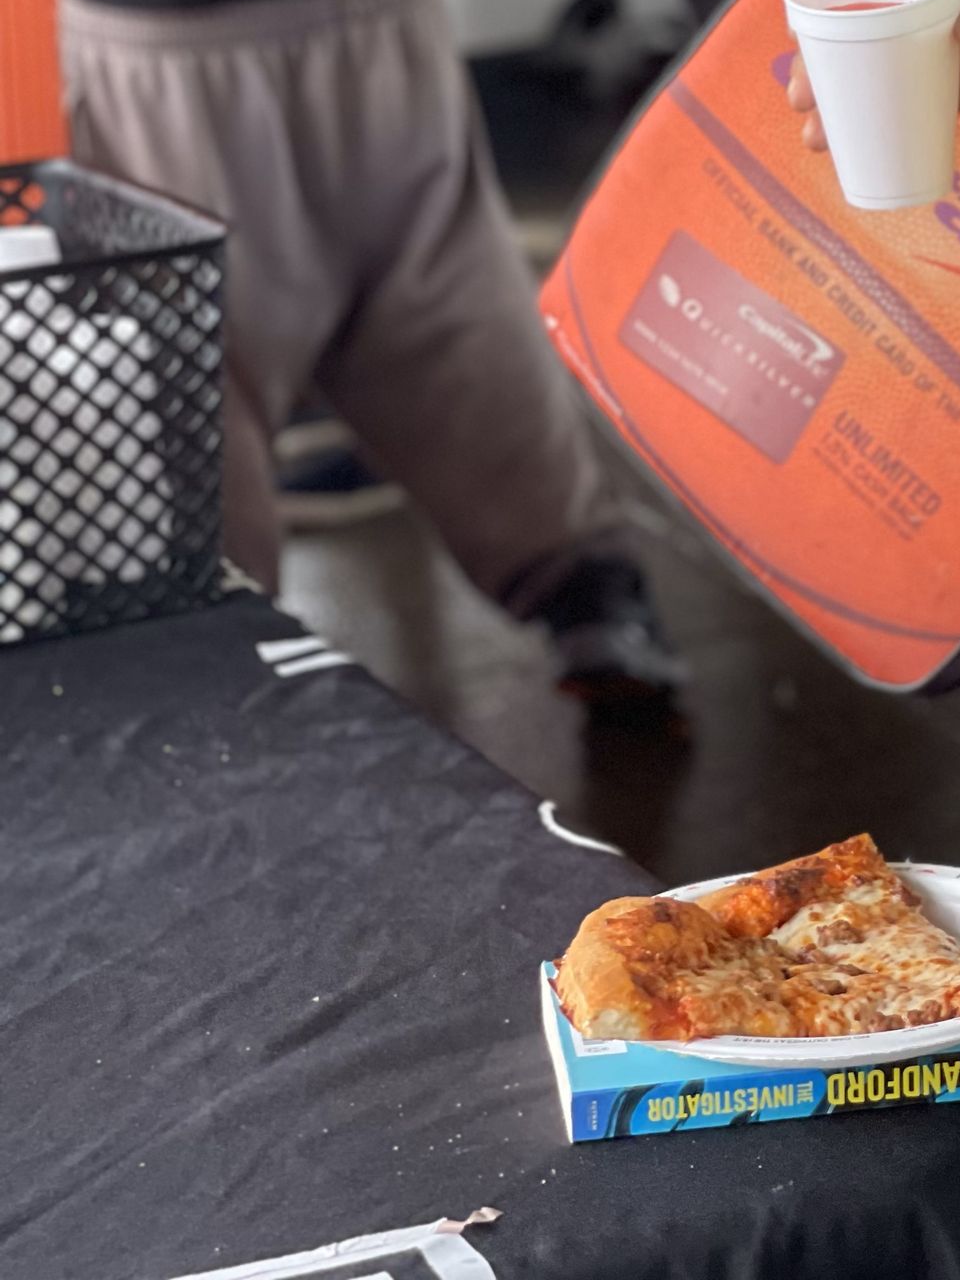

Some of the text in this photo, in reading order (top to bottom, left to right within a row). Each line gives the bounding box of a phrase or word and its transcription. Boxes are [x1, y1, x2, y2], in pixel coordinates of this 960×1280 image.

[756, 216, 797, 258] BANK
[796, 254, 830, 289] AND
[824, 282, 878, 339] CREDIT
[871, 331, 919, 378] CARD
[910, 370, 938, 397] OF
[830, 408, 945, 517] UNLIMITED
[646, 1083, 794, 1121] INVESTIGATOR
[796, 1080, 813, 1103] THE
